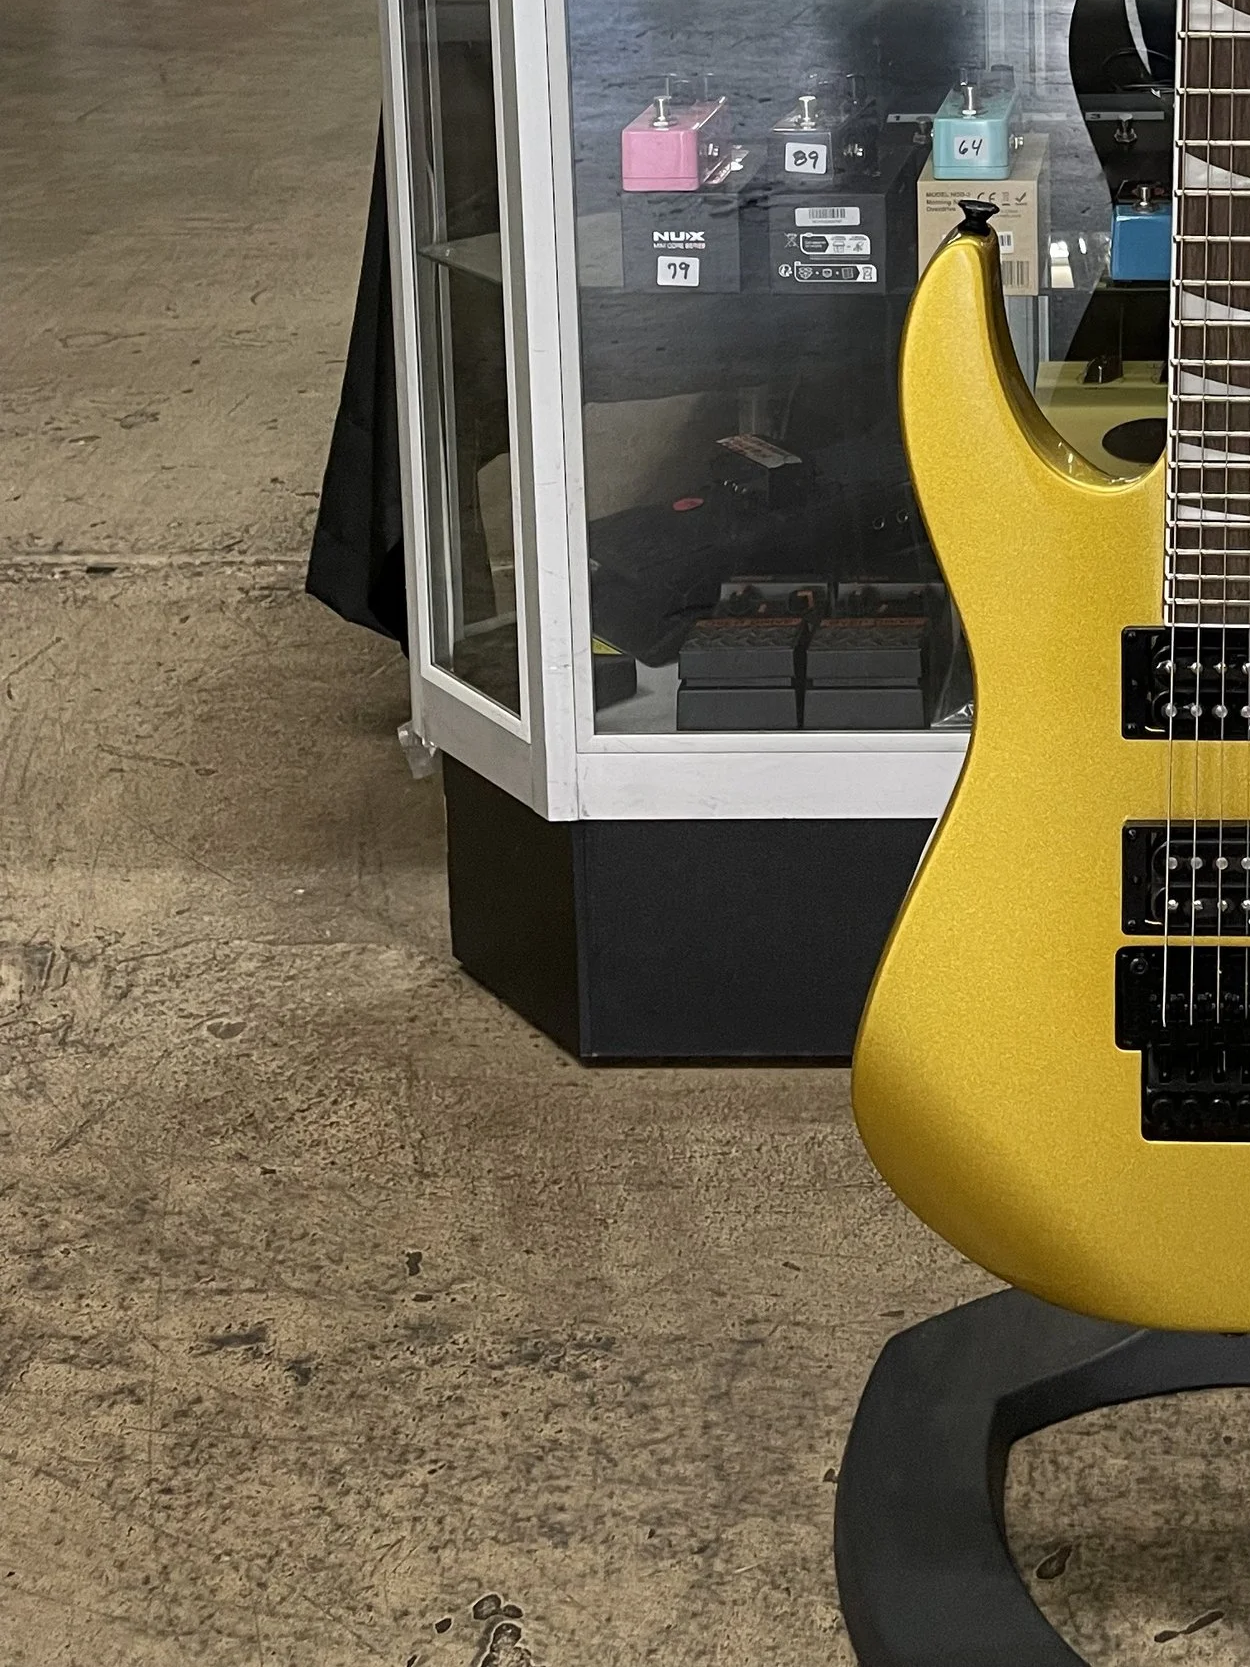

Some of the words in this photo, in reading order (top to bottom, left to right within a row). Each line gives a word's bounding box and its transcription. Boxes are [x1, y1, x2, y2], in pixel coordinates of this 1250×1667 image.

[957, 137, 983, 157] 64
[792, 149, 821, 170] 89
[653, 231, 705, 242] NUX
[667, 262, 690, 279] 79
